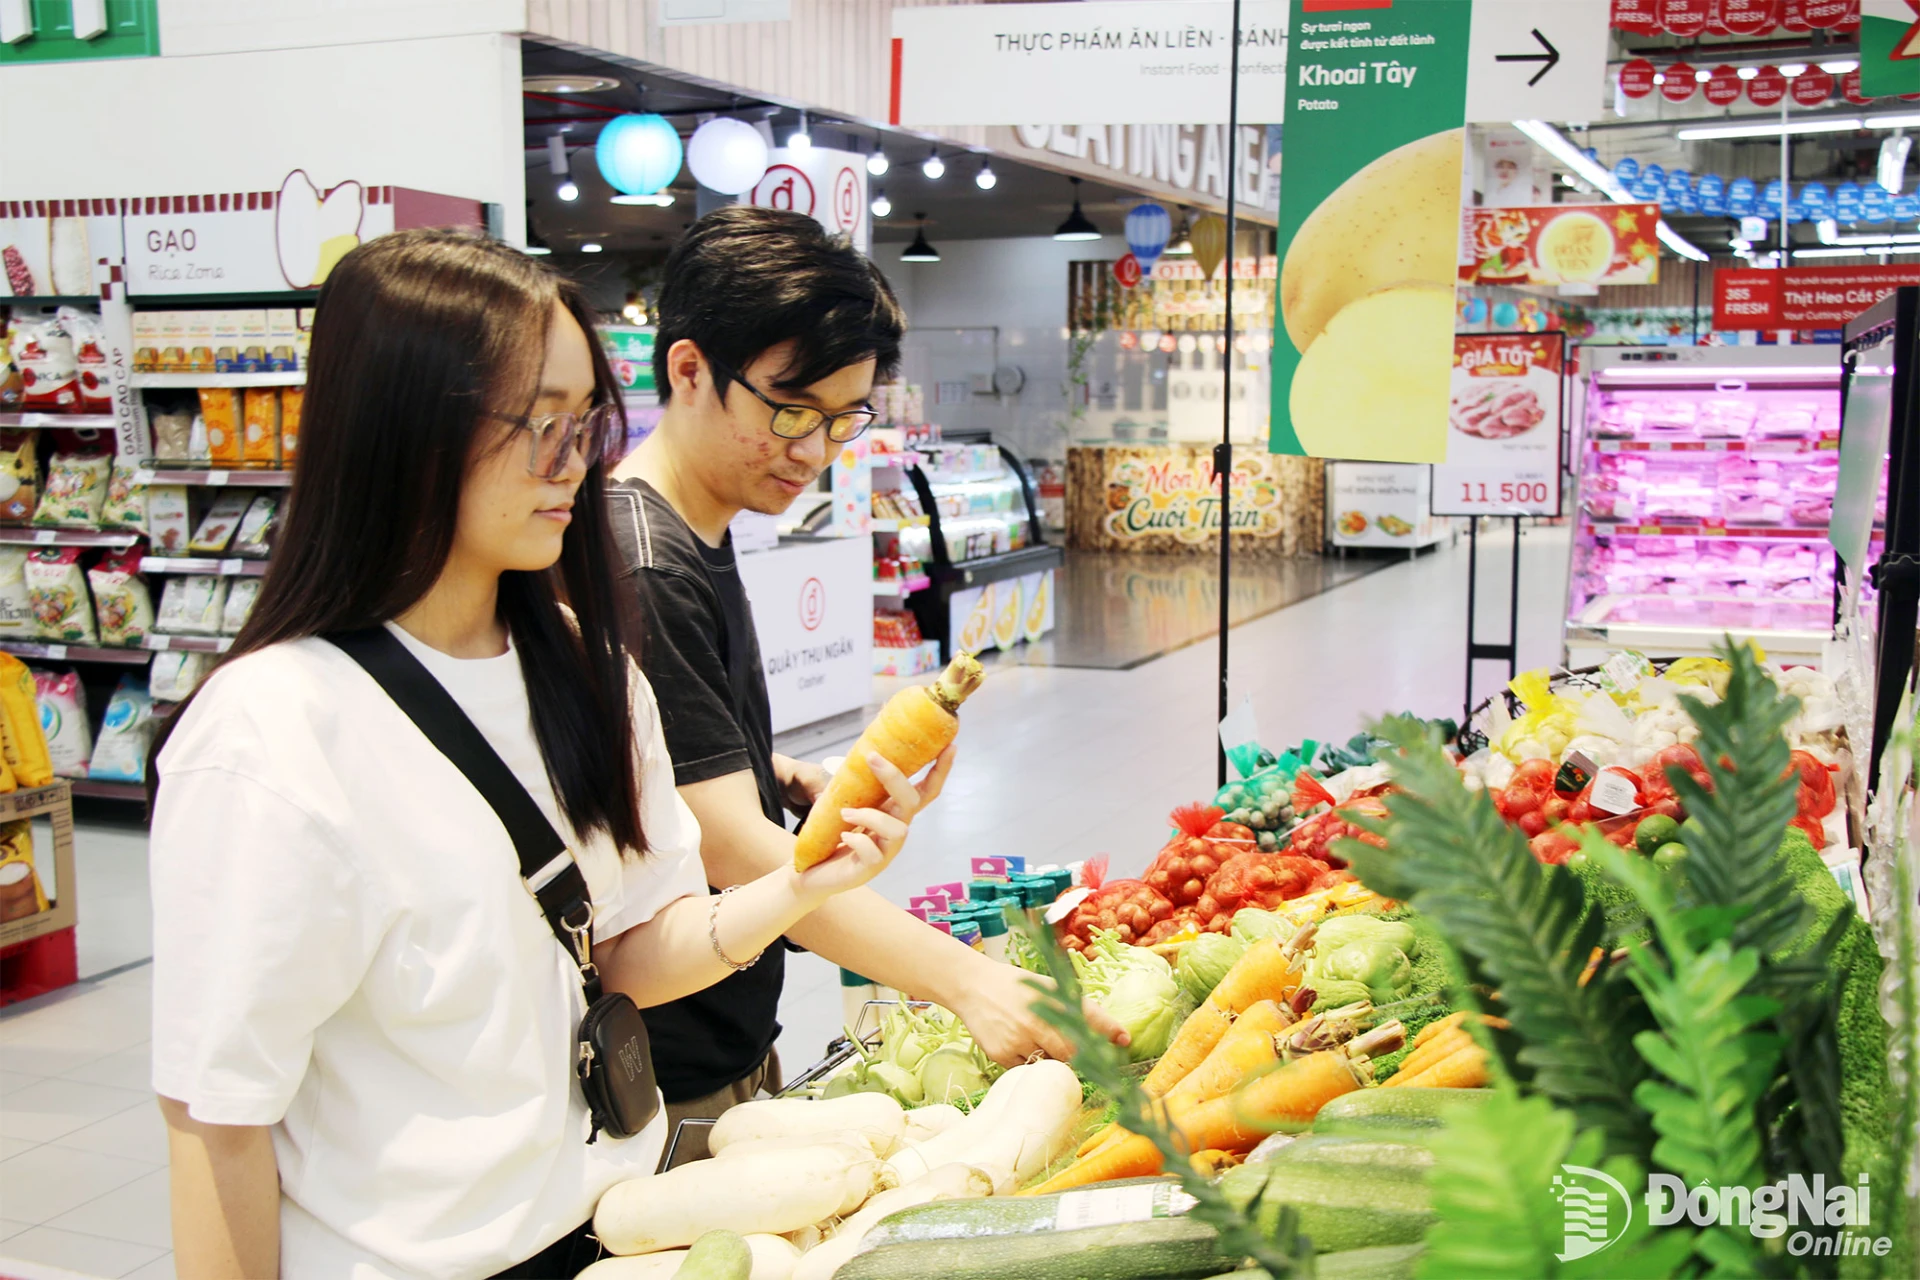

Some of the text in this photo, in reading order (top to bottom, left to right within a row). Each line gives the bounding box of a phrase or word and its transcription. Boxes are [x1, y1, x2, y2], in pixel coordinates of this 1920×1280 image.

[1665, 0, 1688, 11] 365
[1806, 3, 1846, 19] FRESH
[1615, 12, 1653, 23] FRESH
[1665, 13, 1704, 24] FRESH
[1725, 11, 1766, 23] FRESH
[1343, 21, 1371, 33] ngon
[995, 32, 1053, 56] THỰC
[1059, 25, 1122, 50] PHẨM
[1128, 26, 1158, 49] ĂN
[1165, 25, 1213, 48] LIỀN
[1409, 33, 1436, 46] lành
[1140, 63, 1185, 76] Instant
[1188, 62, 1220, 76] Food
[1298, 60, 1418, 88] Khoai Tây
[1297, 99, 1339, 111] Potato
[147, 228, 196, 258] GẠO
[148, 262, 225, 280] Rice Zone
[1725, 288, 1750, 301] 365
[1784, 291, 1813, 308] Thịt
[1816, 290, 1844, 305] Heo
[1725, 302, 1769, 315] FRESH
[1783, 311, 1804, 321] Your
[1462, 343, 1535, 370] GIÁ TỐT
[1127, 495, 1186, 531] Cuối
[801, 645, 823, 667] THU
[825, 635, 854, 661] NGÂN
